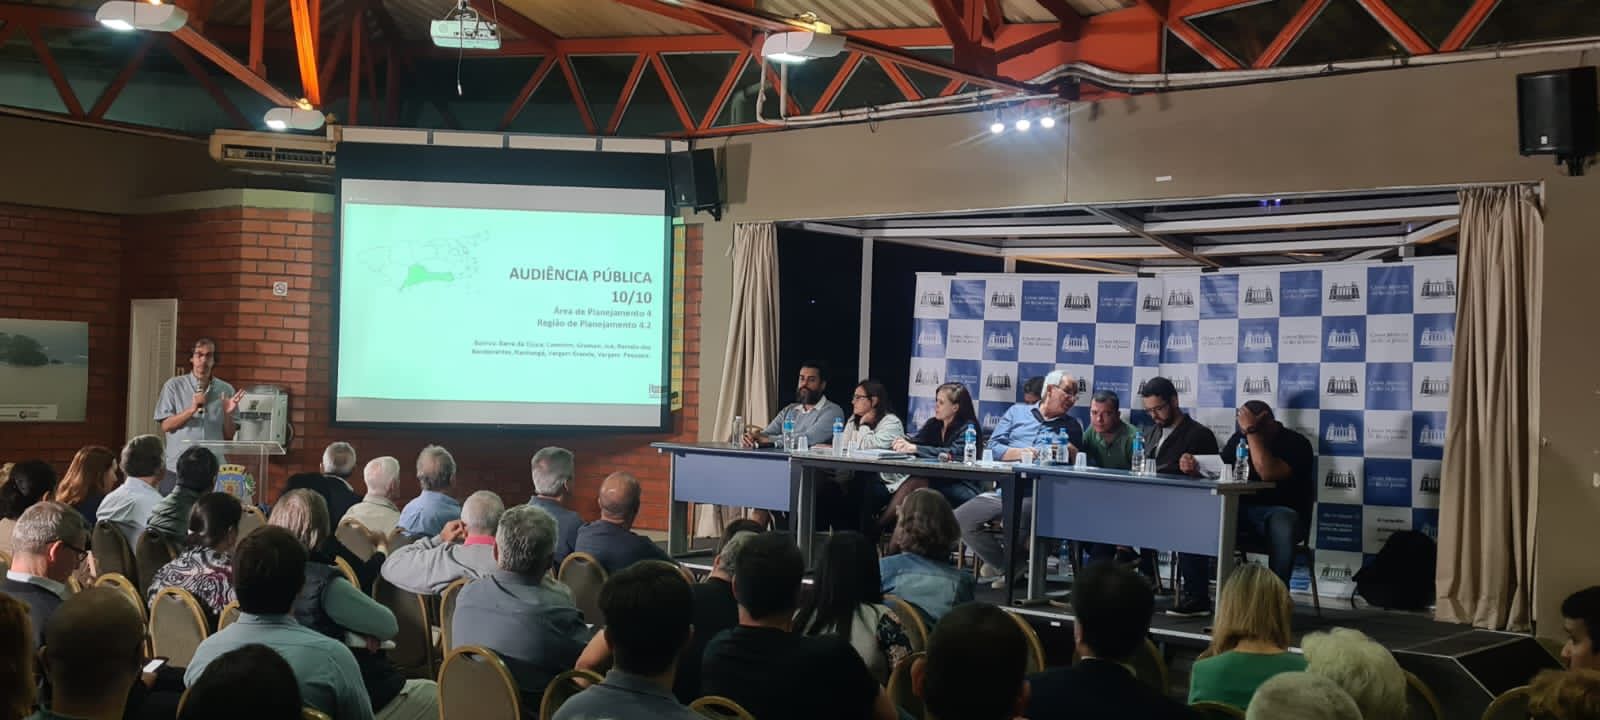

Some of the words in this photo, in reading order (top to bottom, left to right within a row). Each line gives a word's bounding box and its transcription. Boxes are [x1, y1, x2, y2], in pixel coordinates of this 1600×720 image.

[509, 265, 589, 282] AUDIÊNCIA
[593, 267, 652, 284] PÚBLICA
[612, 290, 652, 305] 10/10
[554, 306, 573, 316] Área
[575, 307, 586, 316] de
[587, 308, 645, 318] Planejamento
[647, 309, 652, 317] 4
[537, 319, 565, 329] Região
[567, 319, 578, 328] de
[580, 320, 637, 330] Planejamento
[639, 321, 651, 329] 4.2
